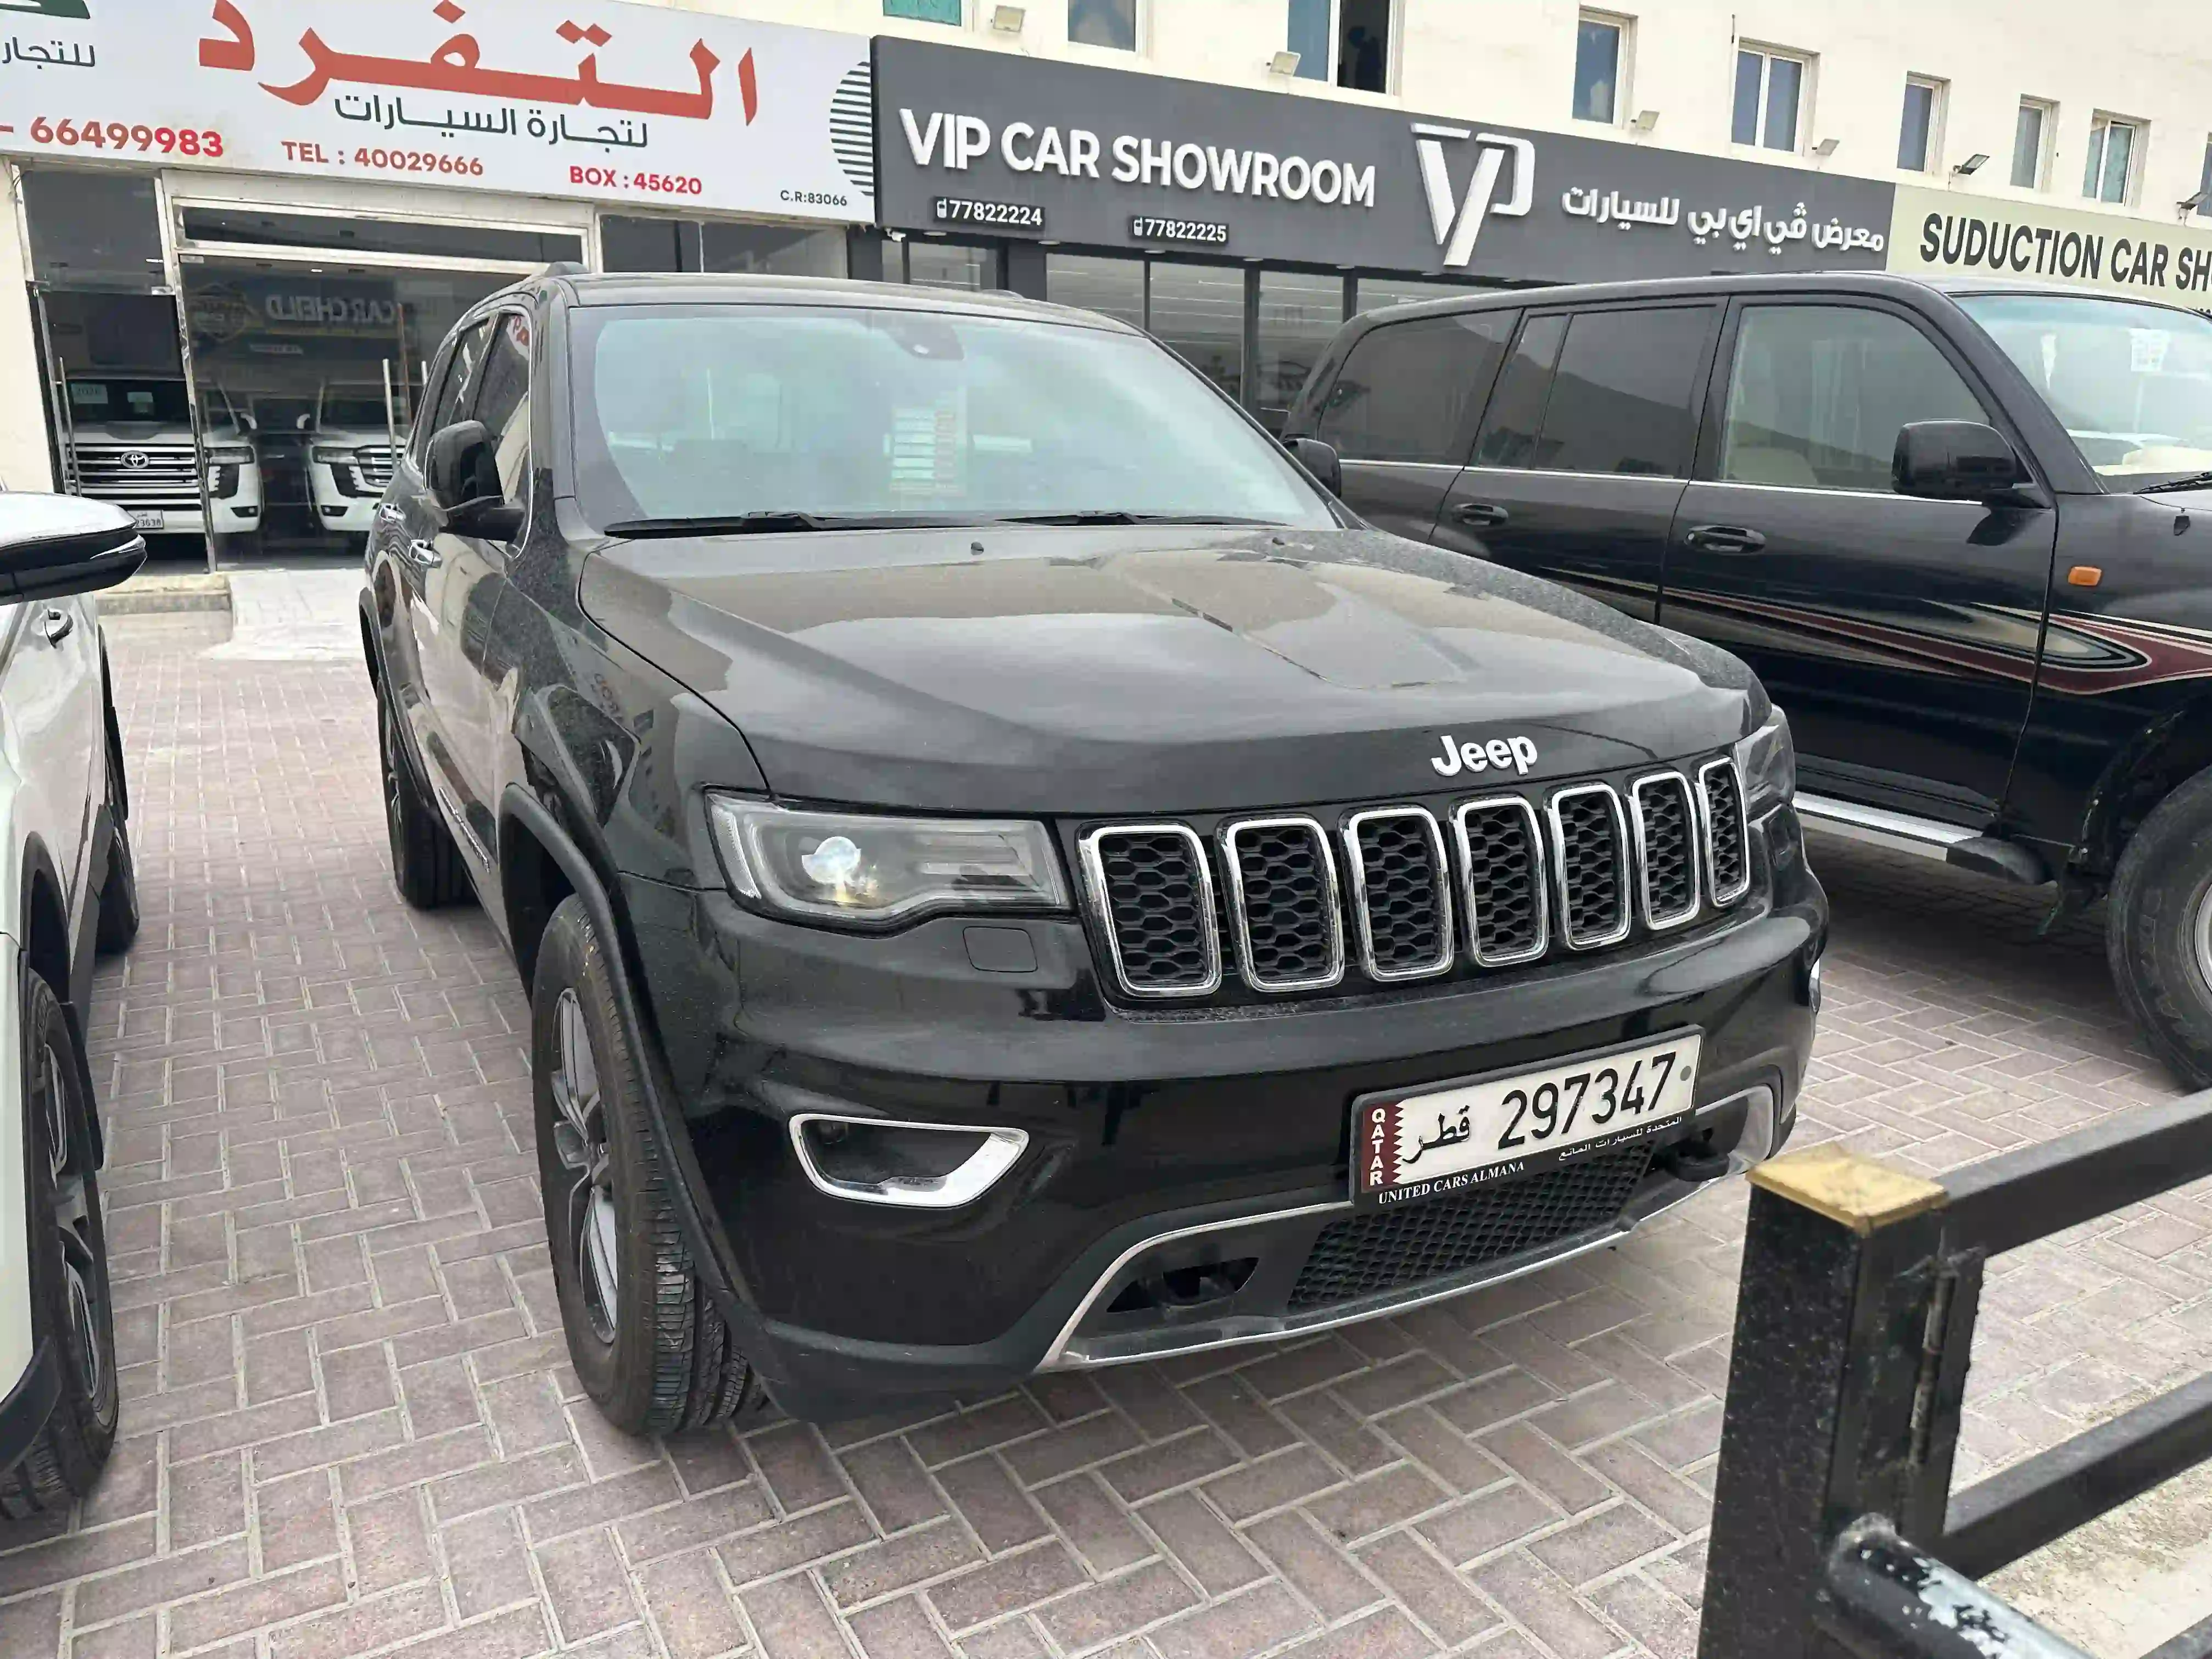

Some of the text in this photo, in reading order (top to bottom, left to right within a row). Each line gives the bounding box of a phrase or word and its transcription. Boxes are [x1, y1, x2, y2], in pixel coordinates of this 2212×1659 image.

[198, 0, 759, 126] التفرد
[30, 116, 225, 158] 66499983
[334, 94, 649, 154] لتجارة السيارات
[281, 141, 328, 164] TEL
[354, 147, 484, 176] 40029666
[899, 108, 1376, 208] VIP CAR SHOWROOM
[569, 165, 617, 188] BOX
[633, 172, 703, 195] 45620
[780, 189, 847, 206] C.R:83066
[949, 199, 1043, 226] 77822224
[1561, 186, 1681, 231] للسيارات
[1687, 207, 1728, 245] بي
[1145, 219, 1227, 243] 77822225
[1811, 216, 1885, 252] معرض
[1919, 212, 2212, 292] SUDUCTION CAR SH
[1431, 734, 1538, 777] Jeep
[1498, 1051, 1677, 1150] 297347
[1401, 1104, 1471, 1164] قطر
[1646, 1115, 1682, 1134] المتحدة
[1370, 1108, 1386, 1186] QATAR
[1378, 1161, 1524, 1205] UNITED CARS ALMANA
